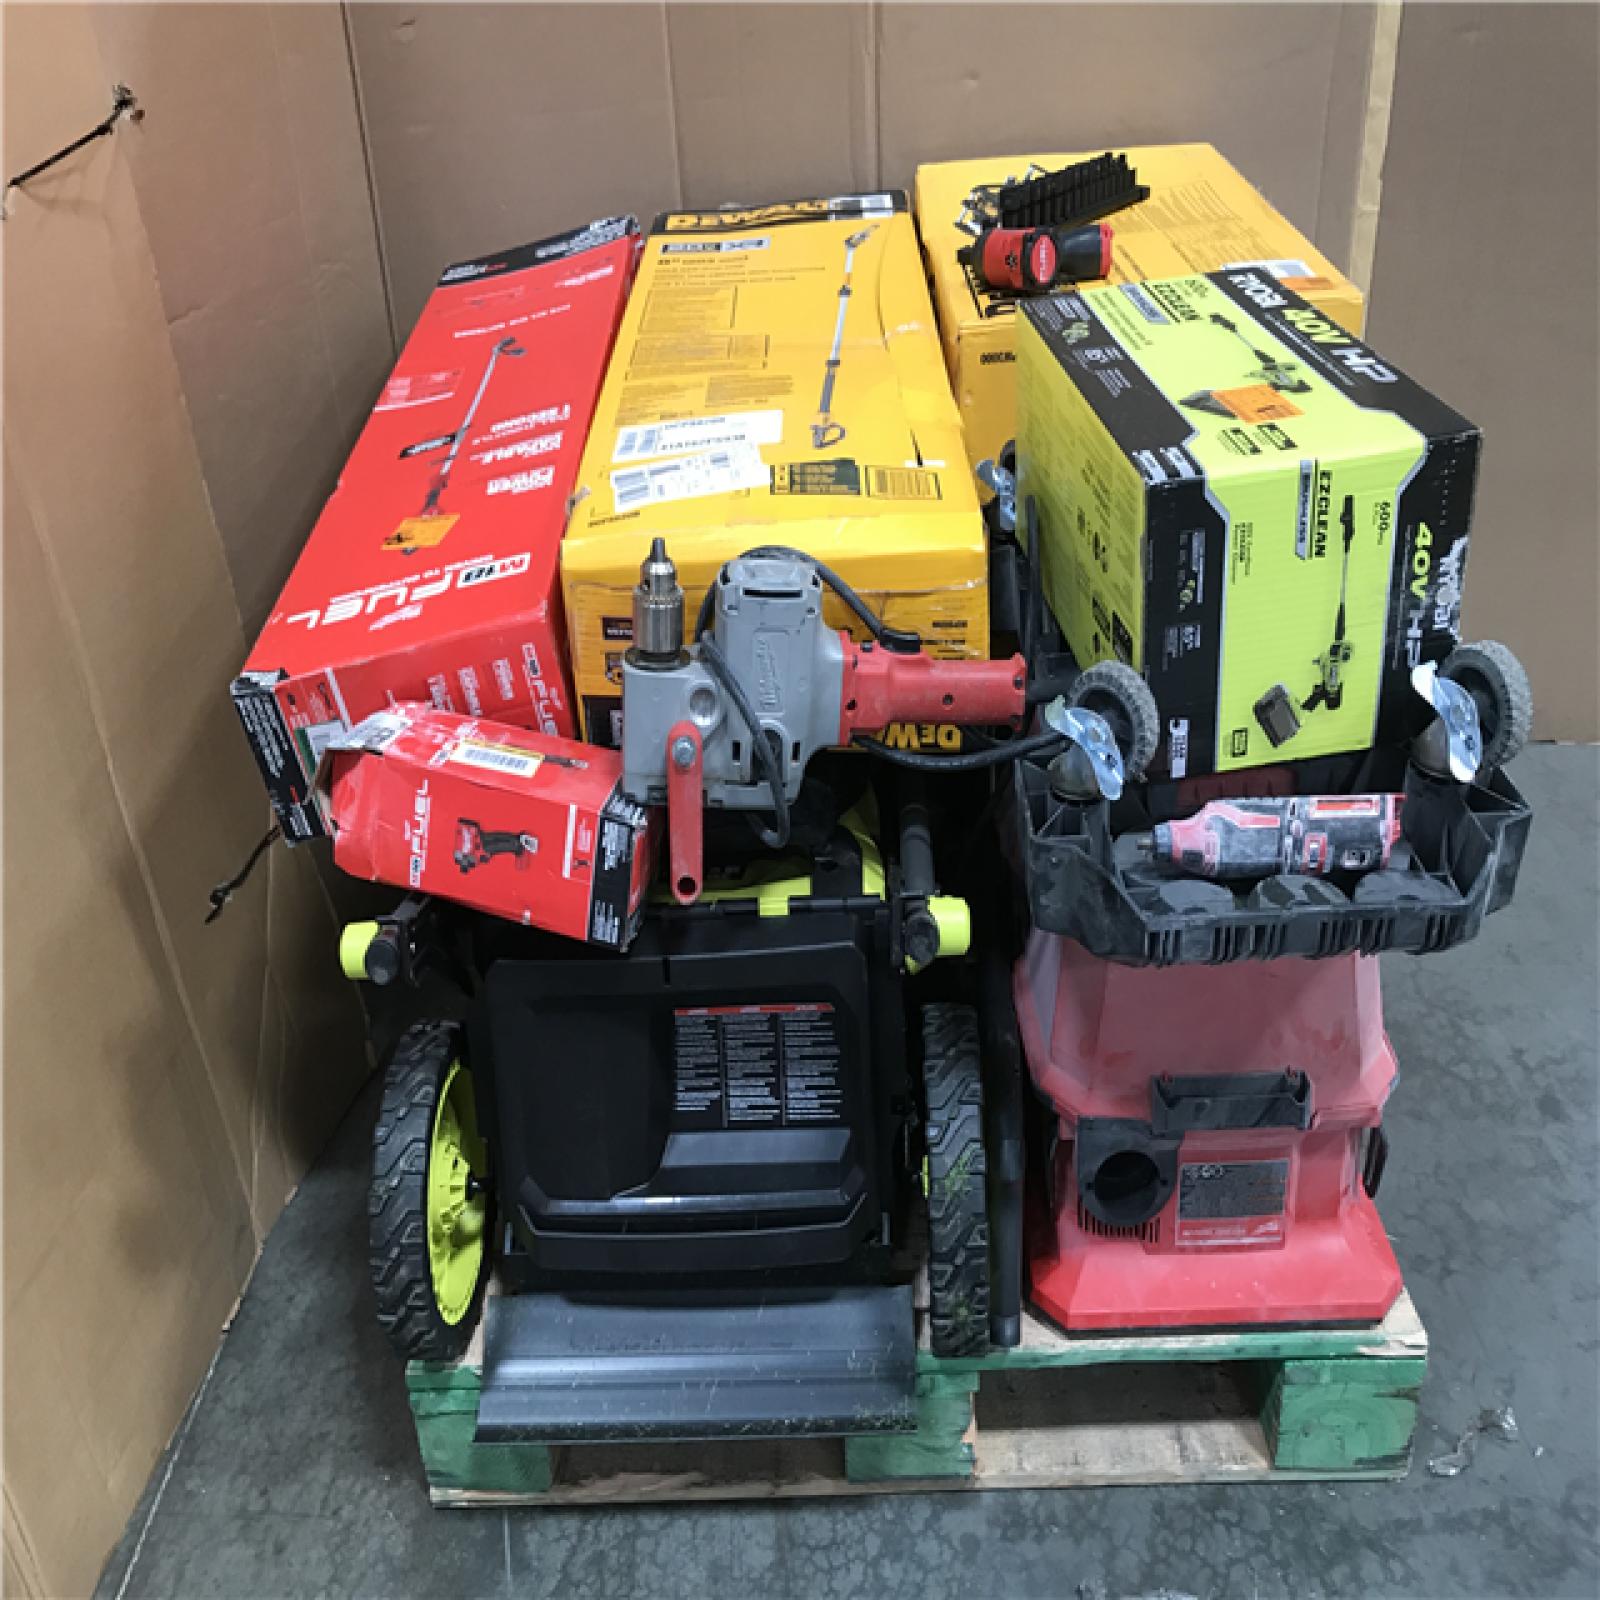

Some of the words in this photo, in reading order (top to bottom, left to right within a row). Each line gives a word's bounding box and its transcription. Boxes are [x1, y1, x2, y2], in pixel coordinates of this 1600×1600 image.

[1283, 308, 1352, 345] 40V
[1330, 346, 1399, 384] HP
[1314, 469, 1333, 558] EZCLEAN
[1378, 500, 1391, 531] 600
[1410, 521, 1433, 600] 40V
[286, 571, 453, 630] FUEL
